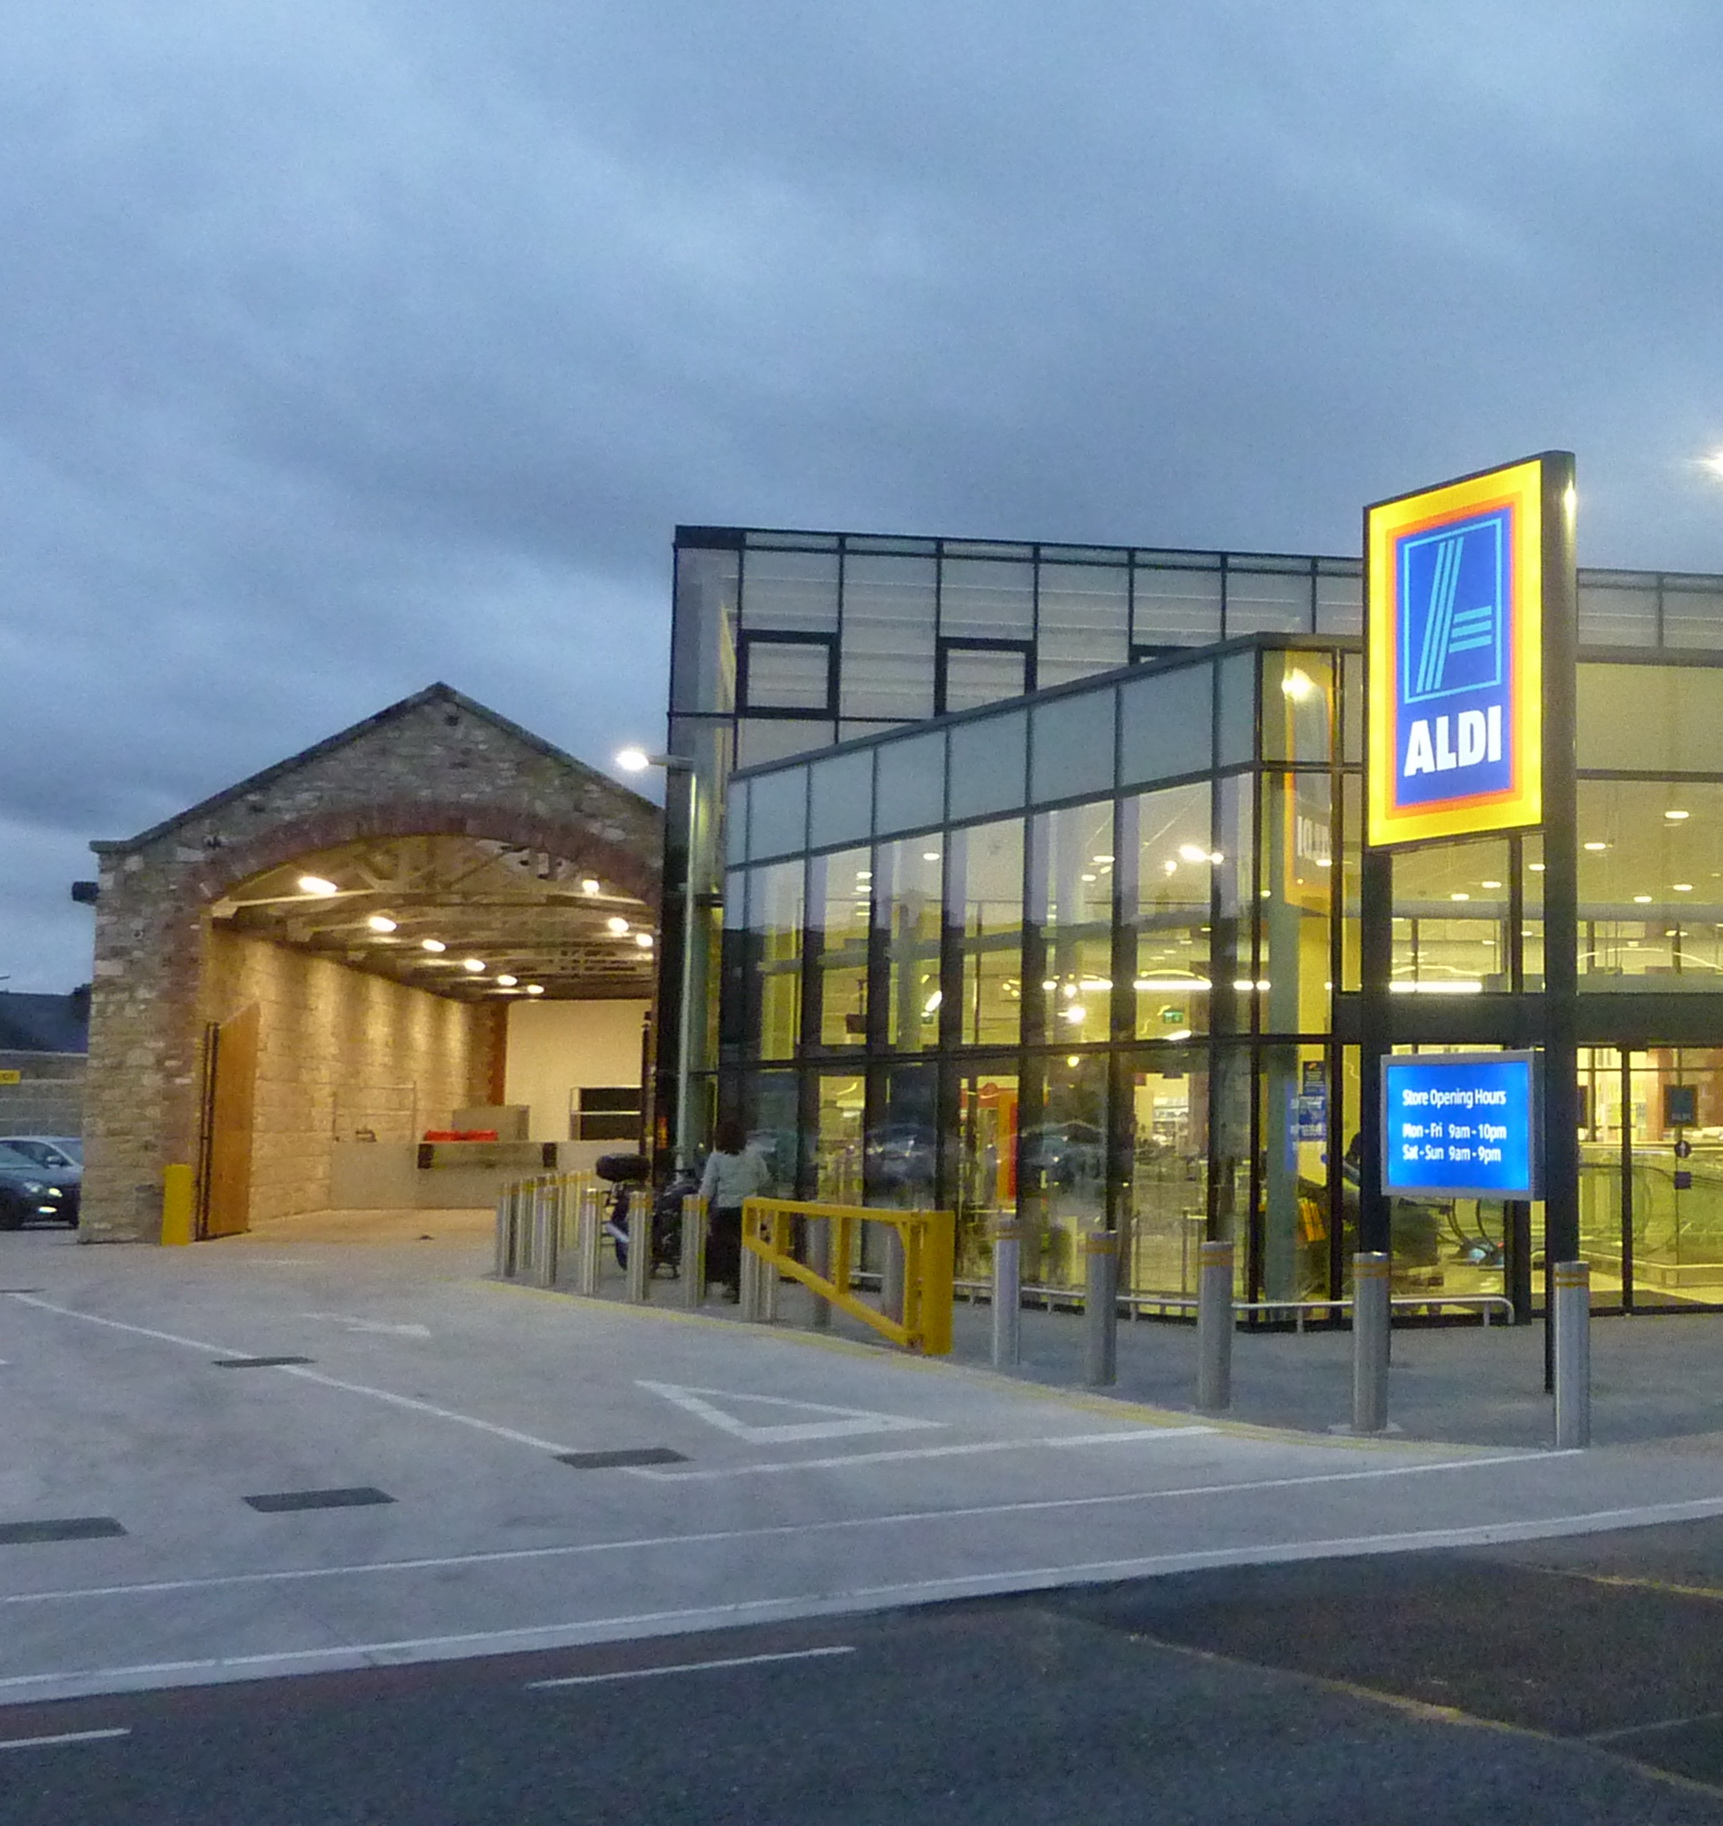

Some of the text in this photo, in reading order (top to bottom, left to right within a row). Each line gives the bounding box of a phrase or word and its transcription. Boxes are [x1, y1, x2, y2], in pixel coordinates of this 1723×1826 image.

[1404, 705, 1502, 777] ALDI
[1403, 1089, 1506, 1108] Store Opening Hours
[1403, 1123, 1423, 1138] Mon
[1430, 1123, 1442, 1137] Fri
[1449, 1124, 1470, 1138] 9am
[1479, 1124, 1506, 1142] 10pm
[1403, 1144, 1418, 1160] Sat
[1425, 1145, 1443, 1160] Sun
[1449, 1146, 1470, 1160] 9am
[1478, 1146, 1501, 1164] 9pm
